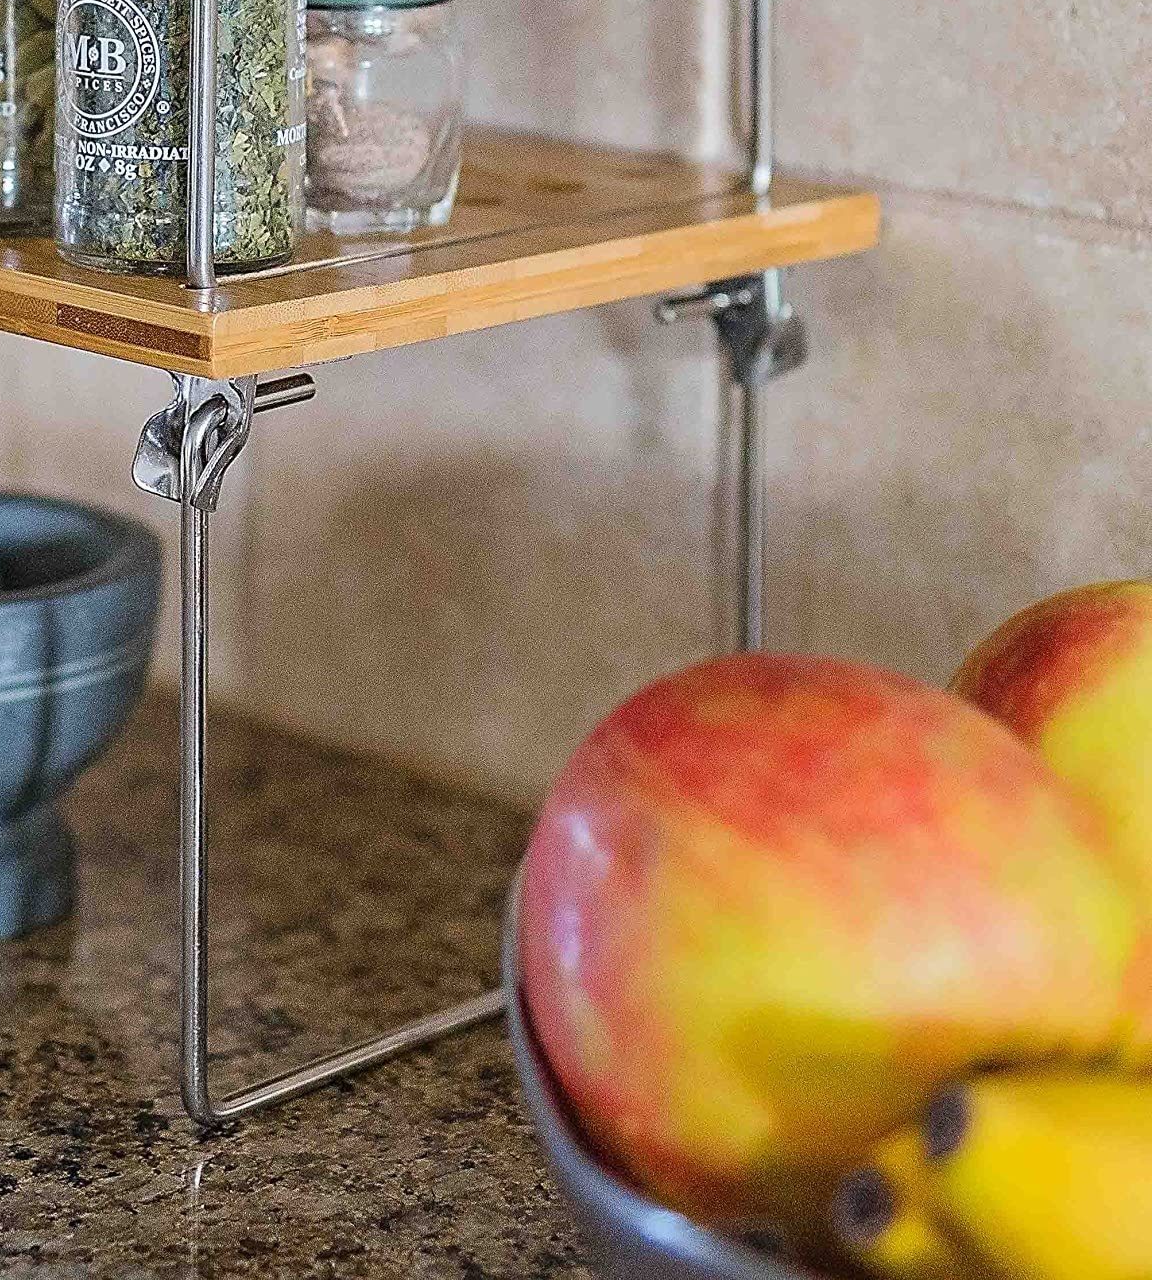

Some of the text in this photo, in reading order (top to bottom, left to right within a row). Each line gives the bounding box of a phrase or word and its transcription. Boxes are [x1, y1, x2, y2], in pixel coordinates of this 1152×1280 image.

[130, 16, 155, 75] SPICES
[74, 92, 145, 134] FRANCISCO
[76, 154, 138, 181] OZ 8g
[78, 140, 189, 161] NON-IRRADIAT
